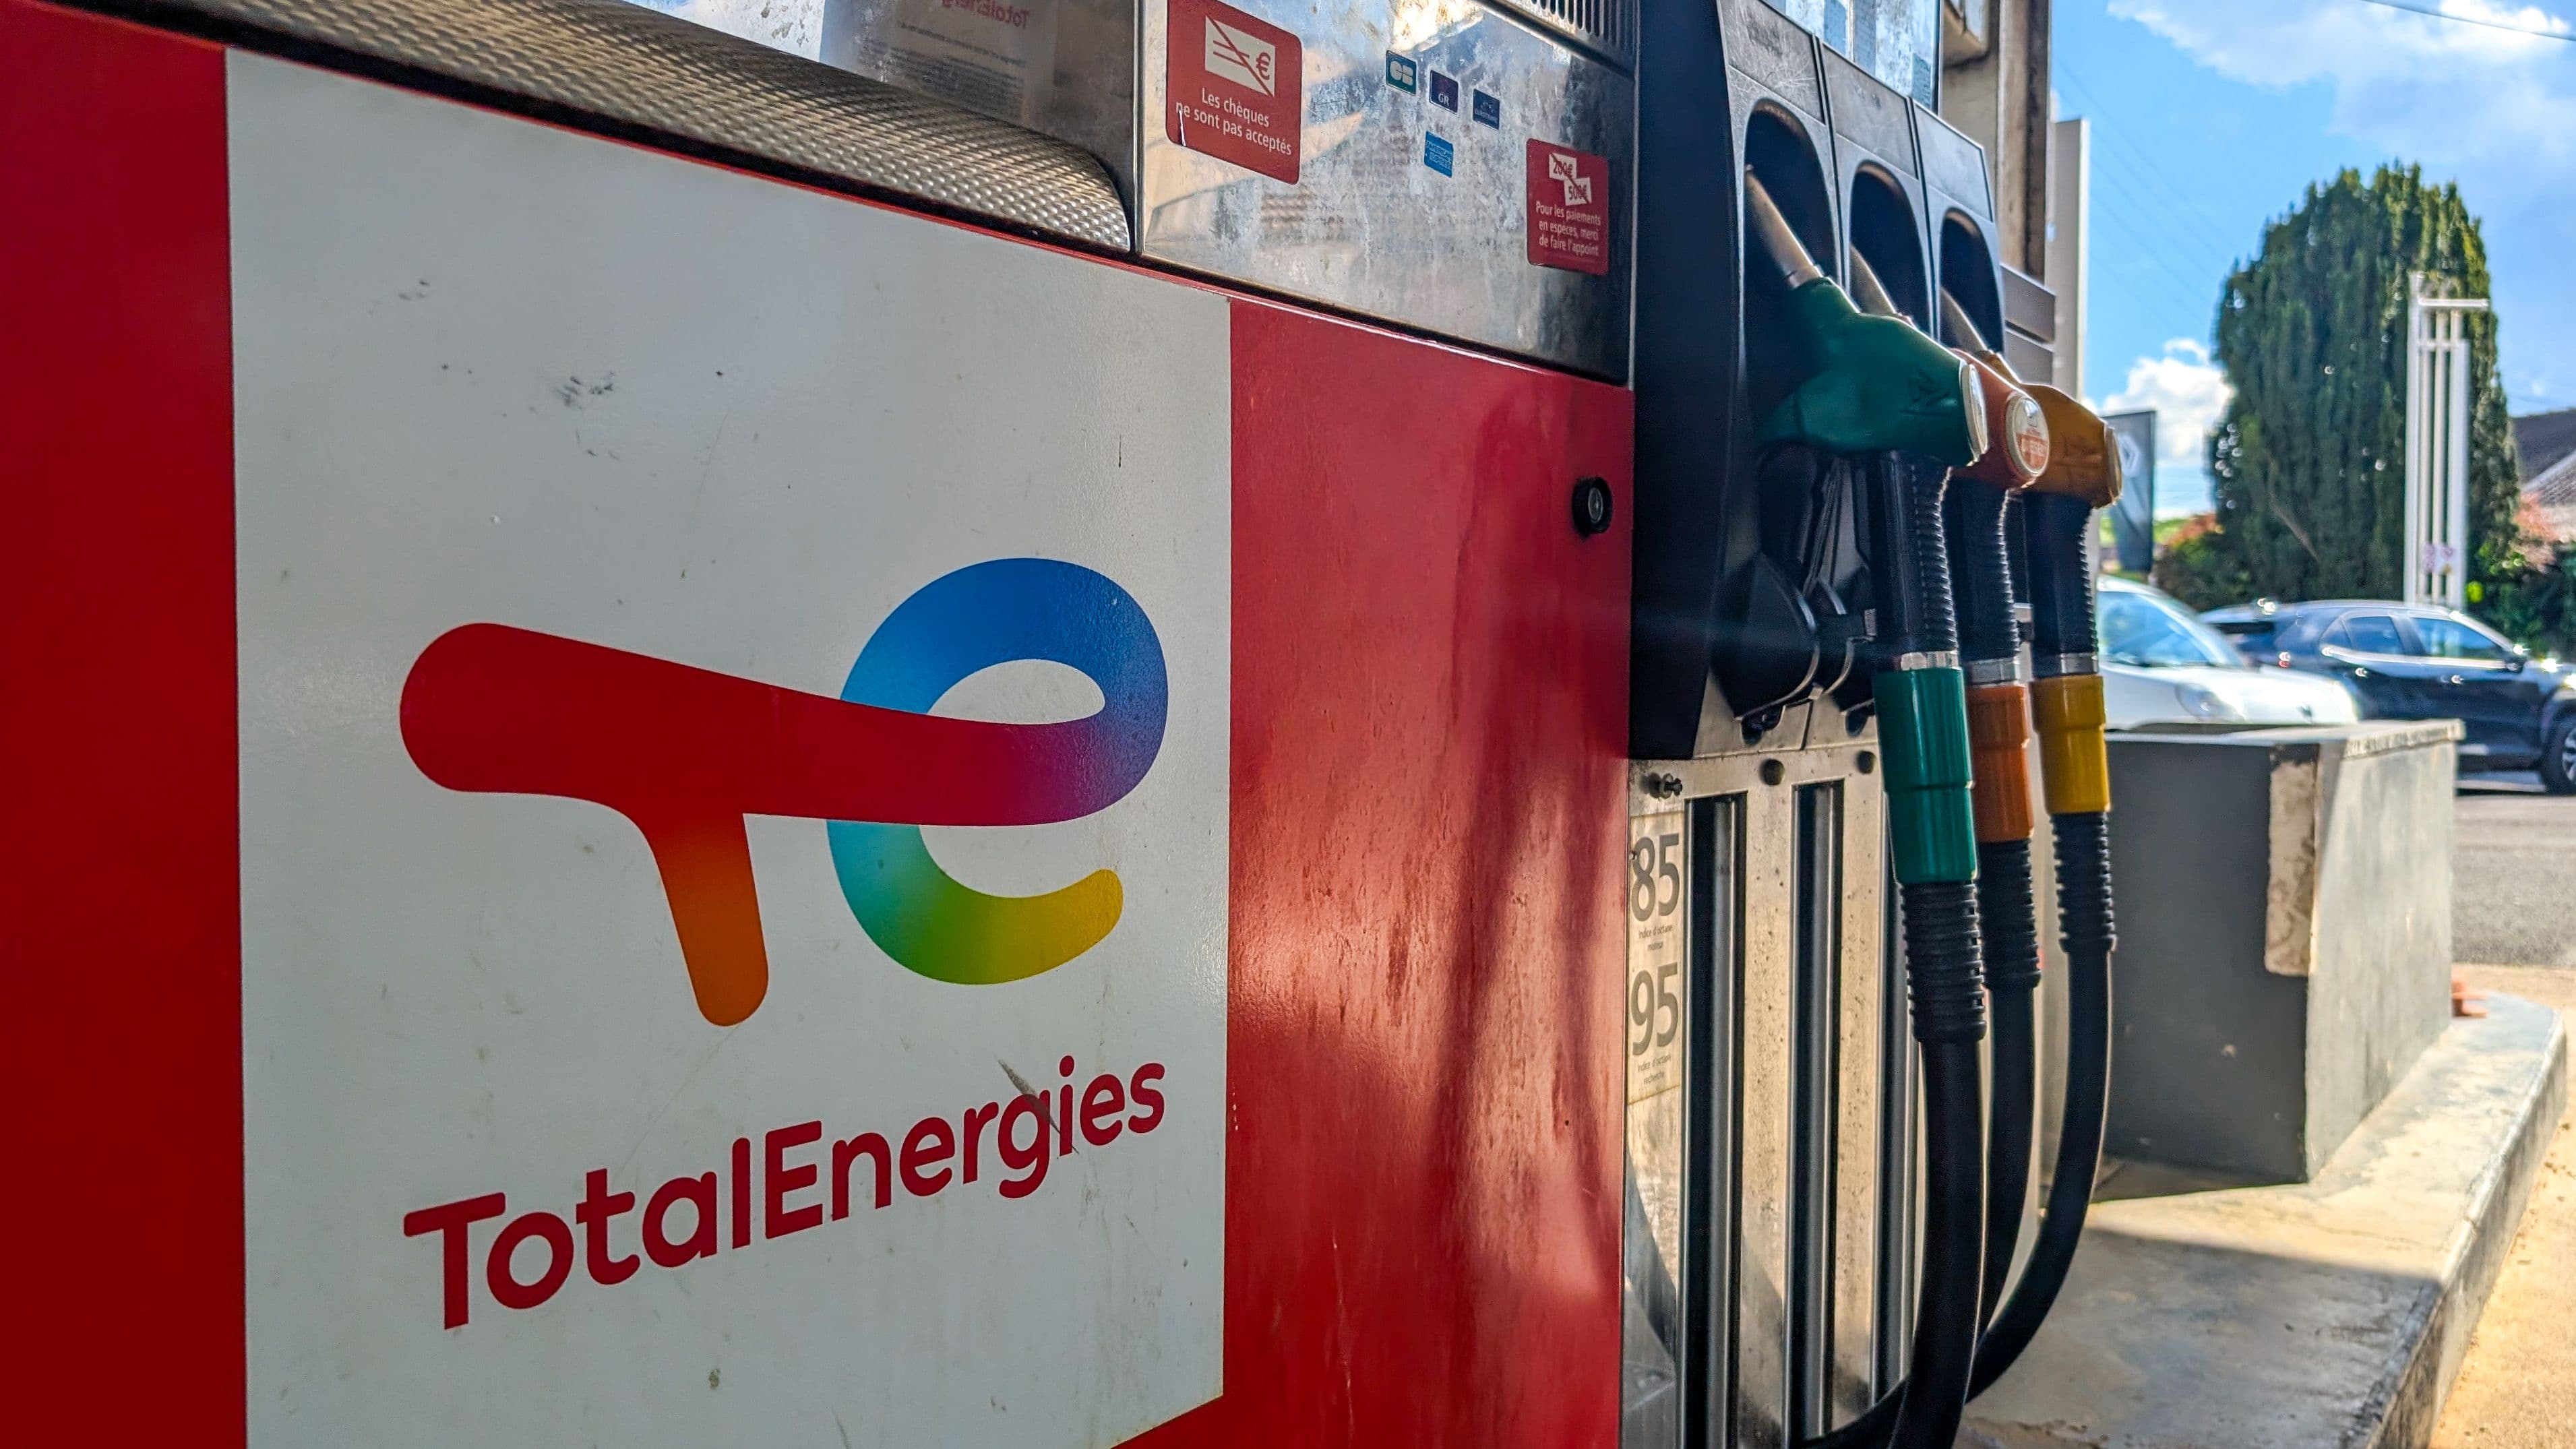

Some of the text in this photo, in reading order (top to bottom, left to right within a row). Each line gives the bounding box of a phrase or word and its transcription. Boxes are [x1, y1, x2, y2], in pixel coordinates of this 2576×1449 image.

[1202, 88, 1270, 128] Les chèques
[1438, 93, 1450, 106] GR
[1176, 102, 1292, 156] ne sont pas acceptés
[1535, 200, 1601, 226] Pour les paiements
[1538, 220, 1548, 231] en
[1581, 227, 1599, 241] merci
[1539, 233, 1599, 257] de faire l'appoint
[1632, 833, 1680, 921] 85
[1631, 962, 1678, 1055] 95
[403, 1055, 1166, 1330] TotalEnergies
